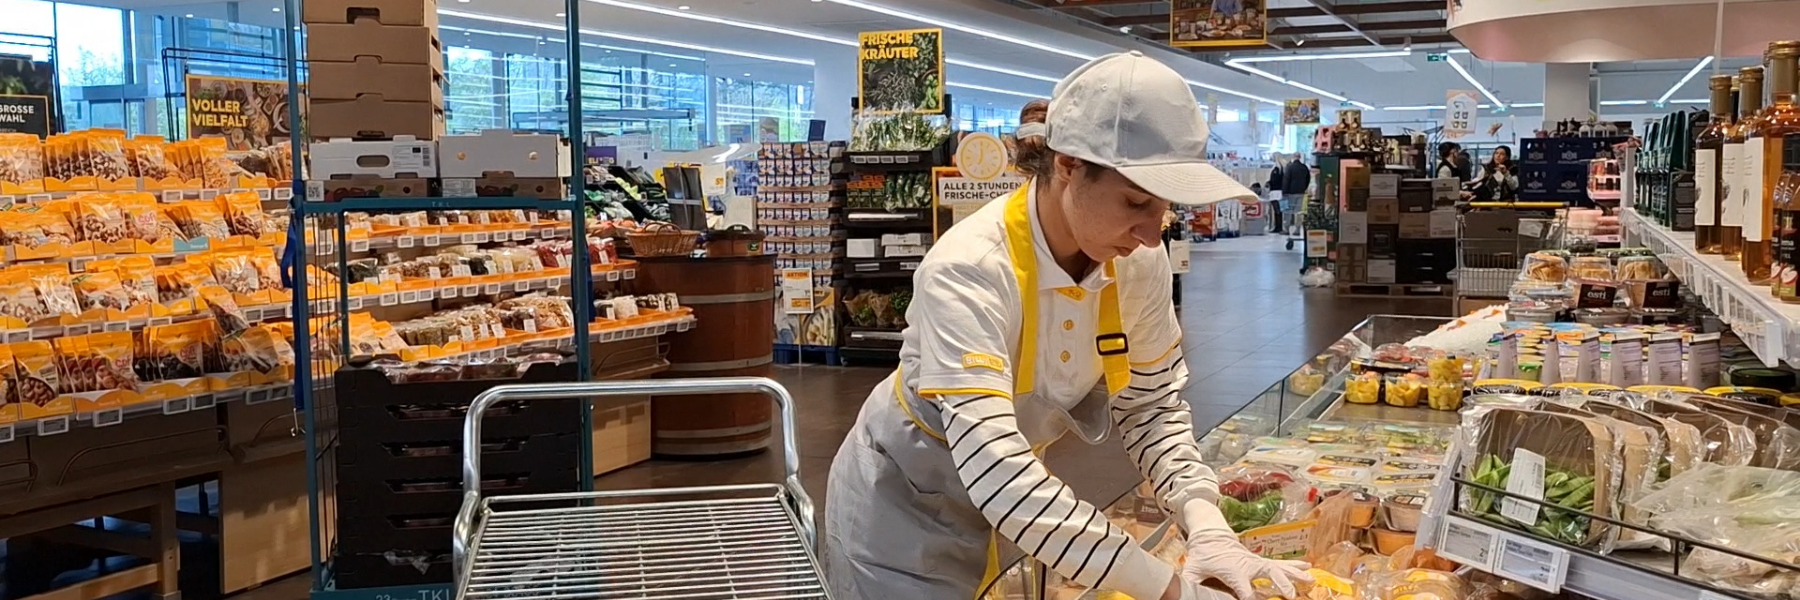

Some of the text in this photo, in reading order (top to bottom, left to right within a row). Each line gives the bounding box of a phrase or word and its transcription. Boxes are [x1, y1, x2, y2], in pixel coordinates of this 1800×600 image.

[861, 32, 913, 45] FRISCHE
[861, 45, 919, 60] KRÄUTER
[191, 99, 240, 113] VOLLER
[192, 113, 248, 127] VIELFALT
[943, 182, 967, 190] ALLE
[969, 182, 975, 190] 2
[1587, 291, 1607, 300] esti
[1652, 288, 1671, 297] esti
